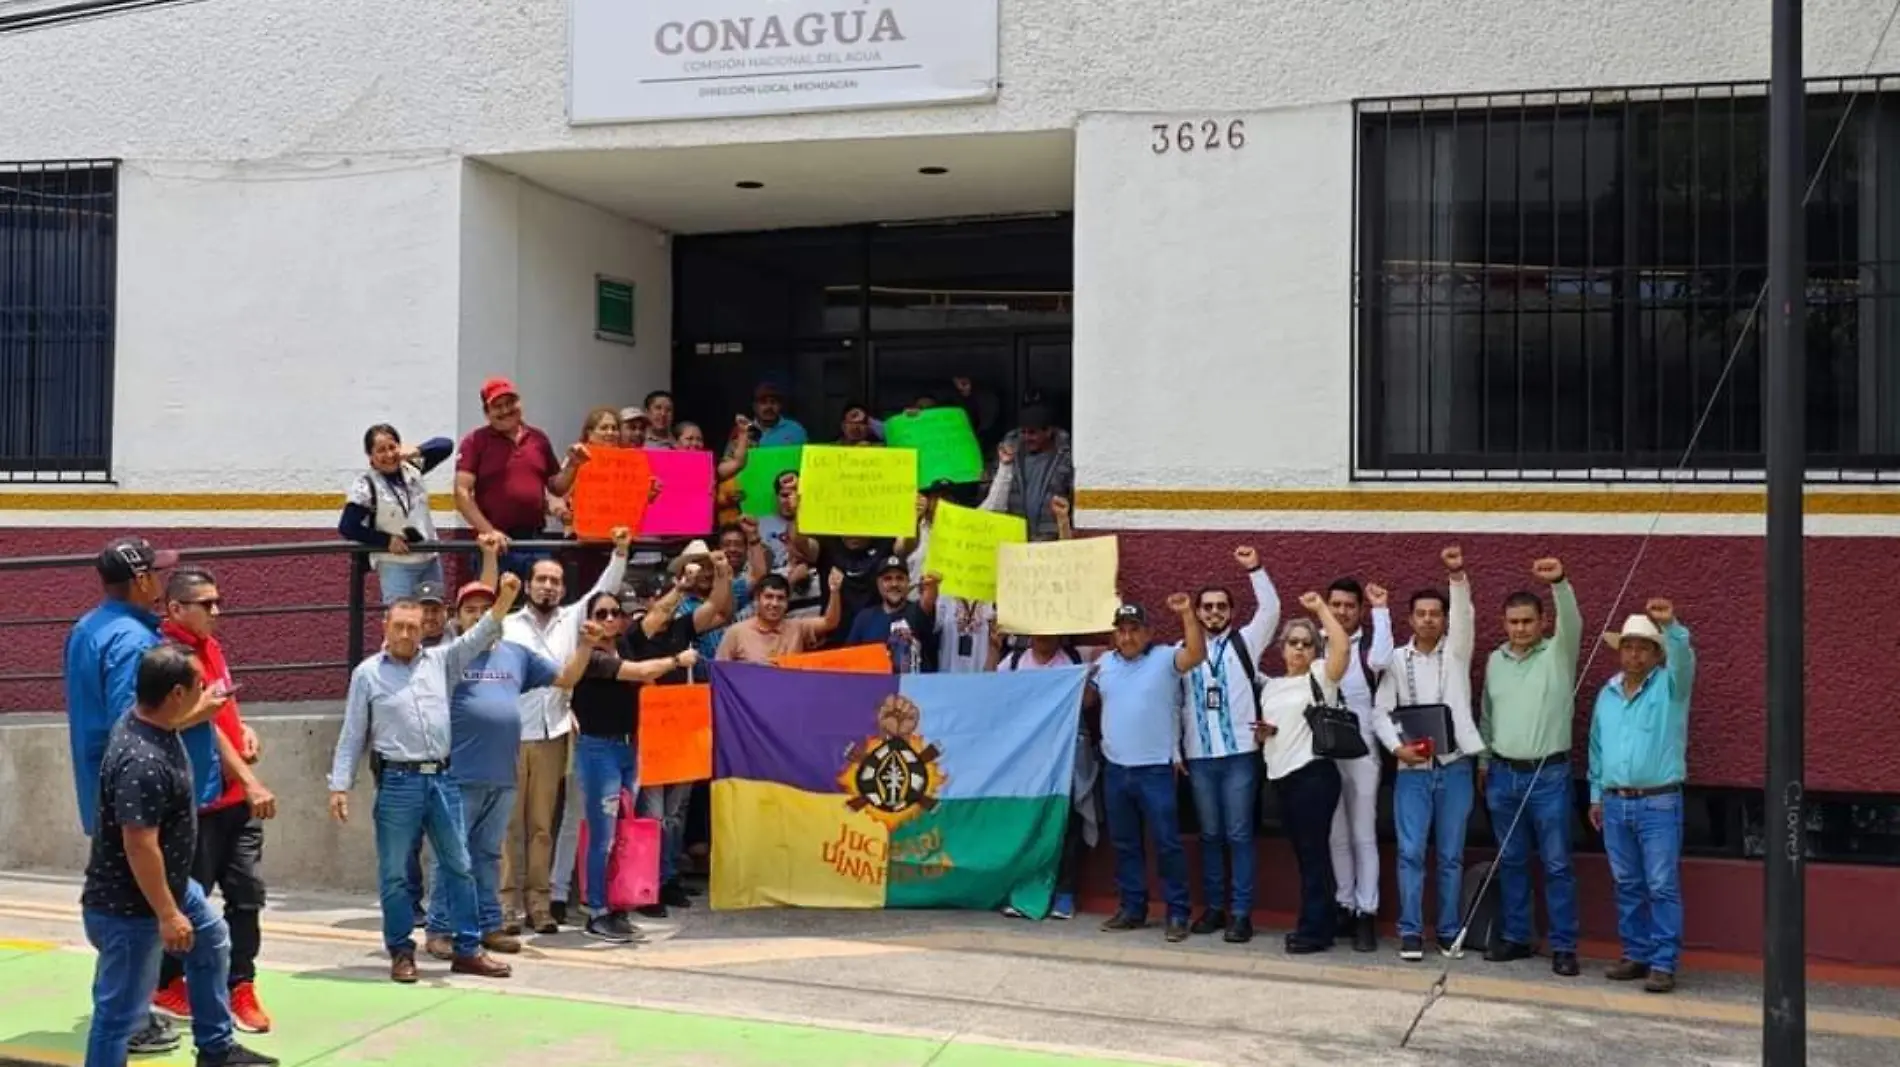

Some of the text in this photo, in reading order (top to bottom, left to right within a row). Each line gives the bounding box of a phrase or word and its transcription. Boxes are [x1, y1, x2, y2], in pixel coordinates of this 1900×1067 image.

[654, 8, 906, 56] CONAGUA
[750, 54, 813, 69] NACIONAL
[817, 53, 840, 64] DEL
[845, 51, 882, 62] AGUA
[1152, 119, 1245, 155] 3626
